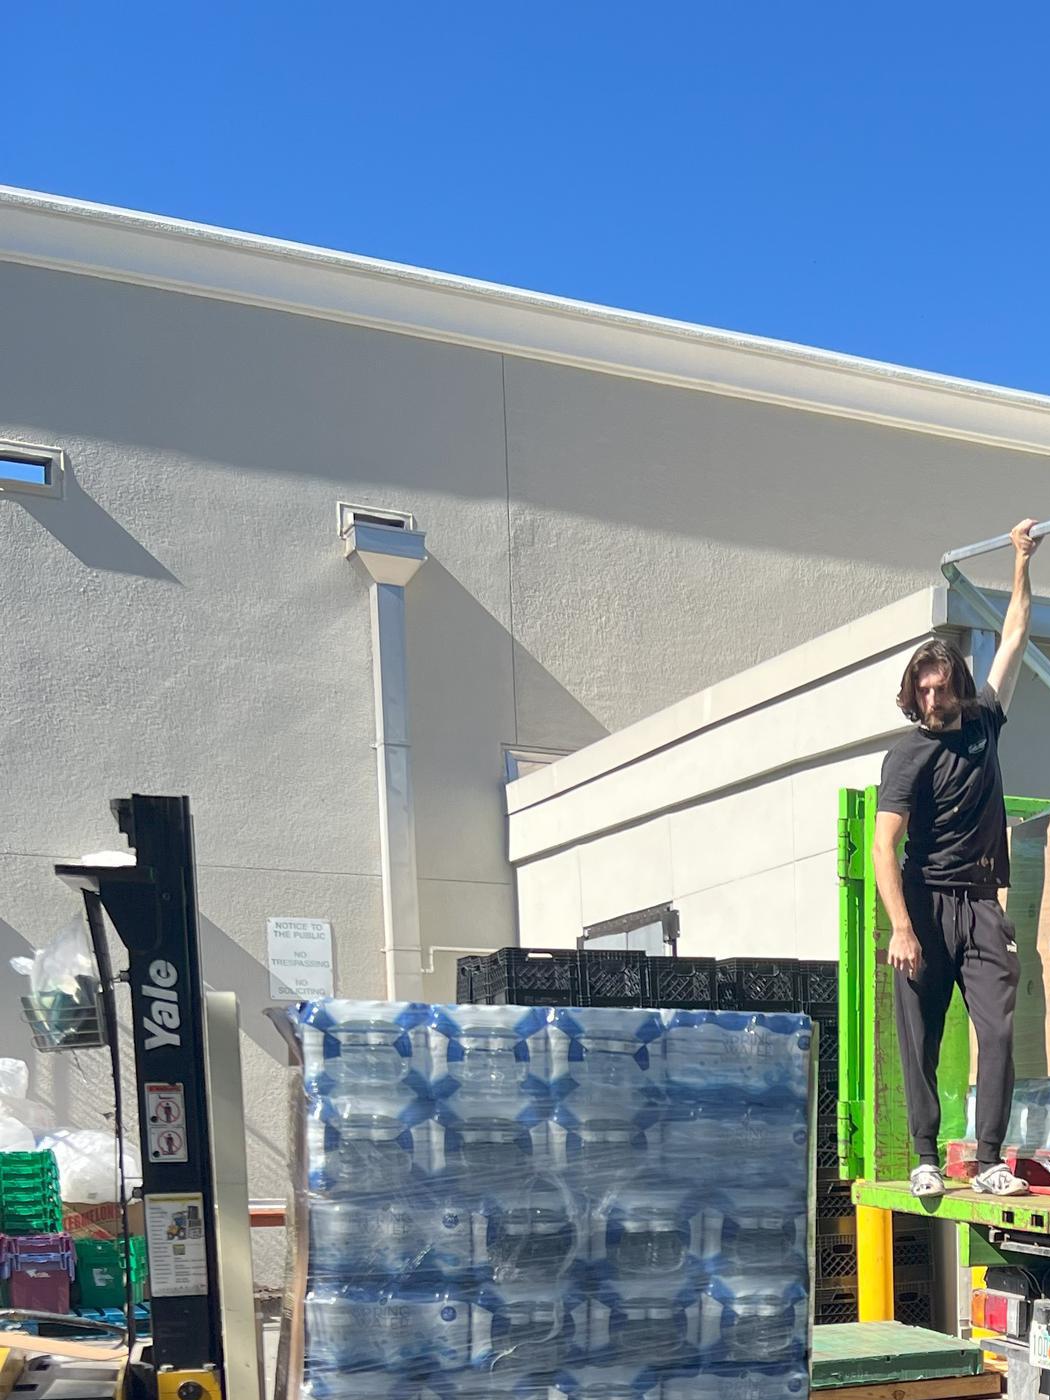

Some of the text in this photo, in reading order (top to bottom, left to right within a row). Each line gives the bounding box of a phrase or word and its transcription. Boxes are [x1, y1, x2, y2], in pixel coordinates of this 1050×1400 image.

[275, 921, 323, 931] NOTICE TO
[273, 930, 326, 940] THE PUBLIC
[294, 951, 308, 959] NO
[271, 958, 330, 968] TRESPASSING
[141, 959, 181, 1050] Yale
